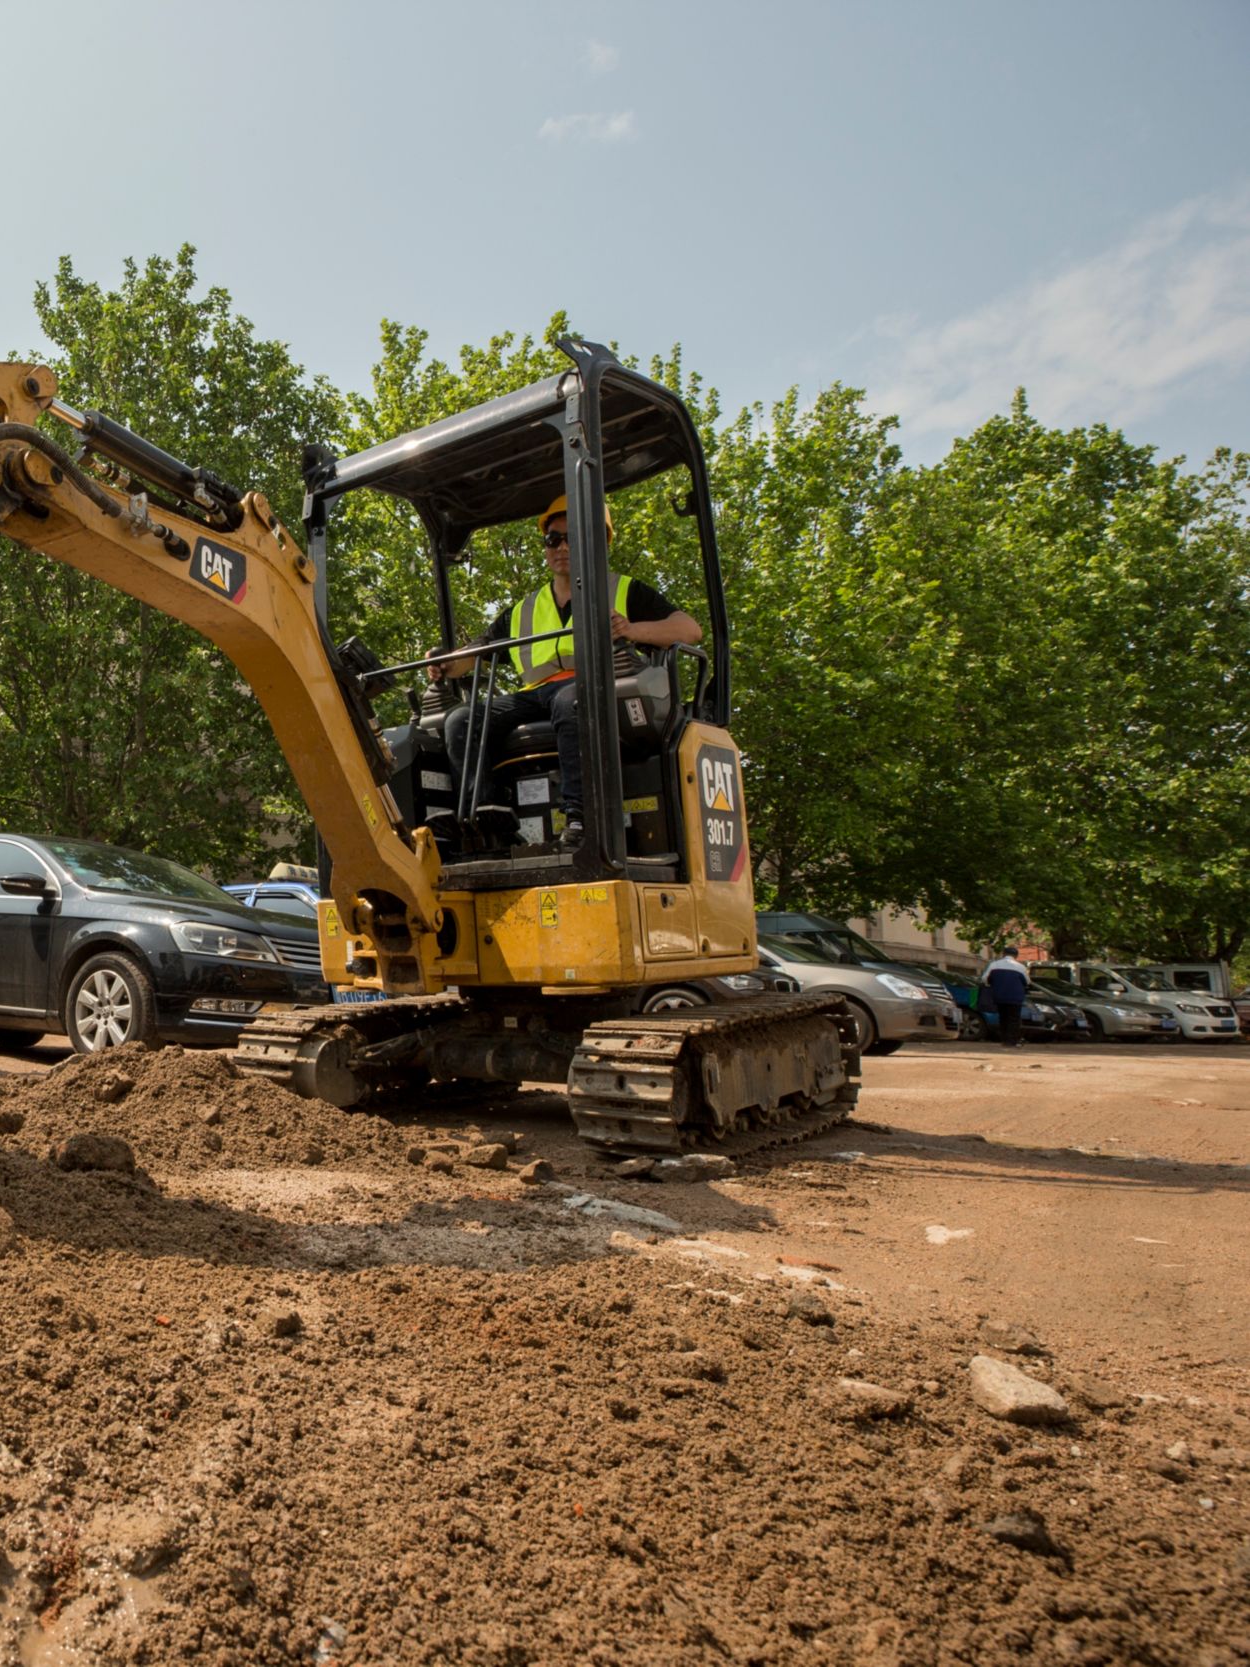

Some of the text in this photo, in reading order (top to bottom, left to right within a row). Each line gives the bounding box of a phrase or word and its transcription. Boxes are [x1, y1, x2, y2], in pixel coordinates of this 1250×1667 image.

[201, 545, 233, 592] CAT
[701, 758, 734, 812] CAT
[707, 818, 734, 846] 301.7
